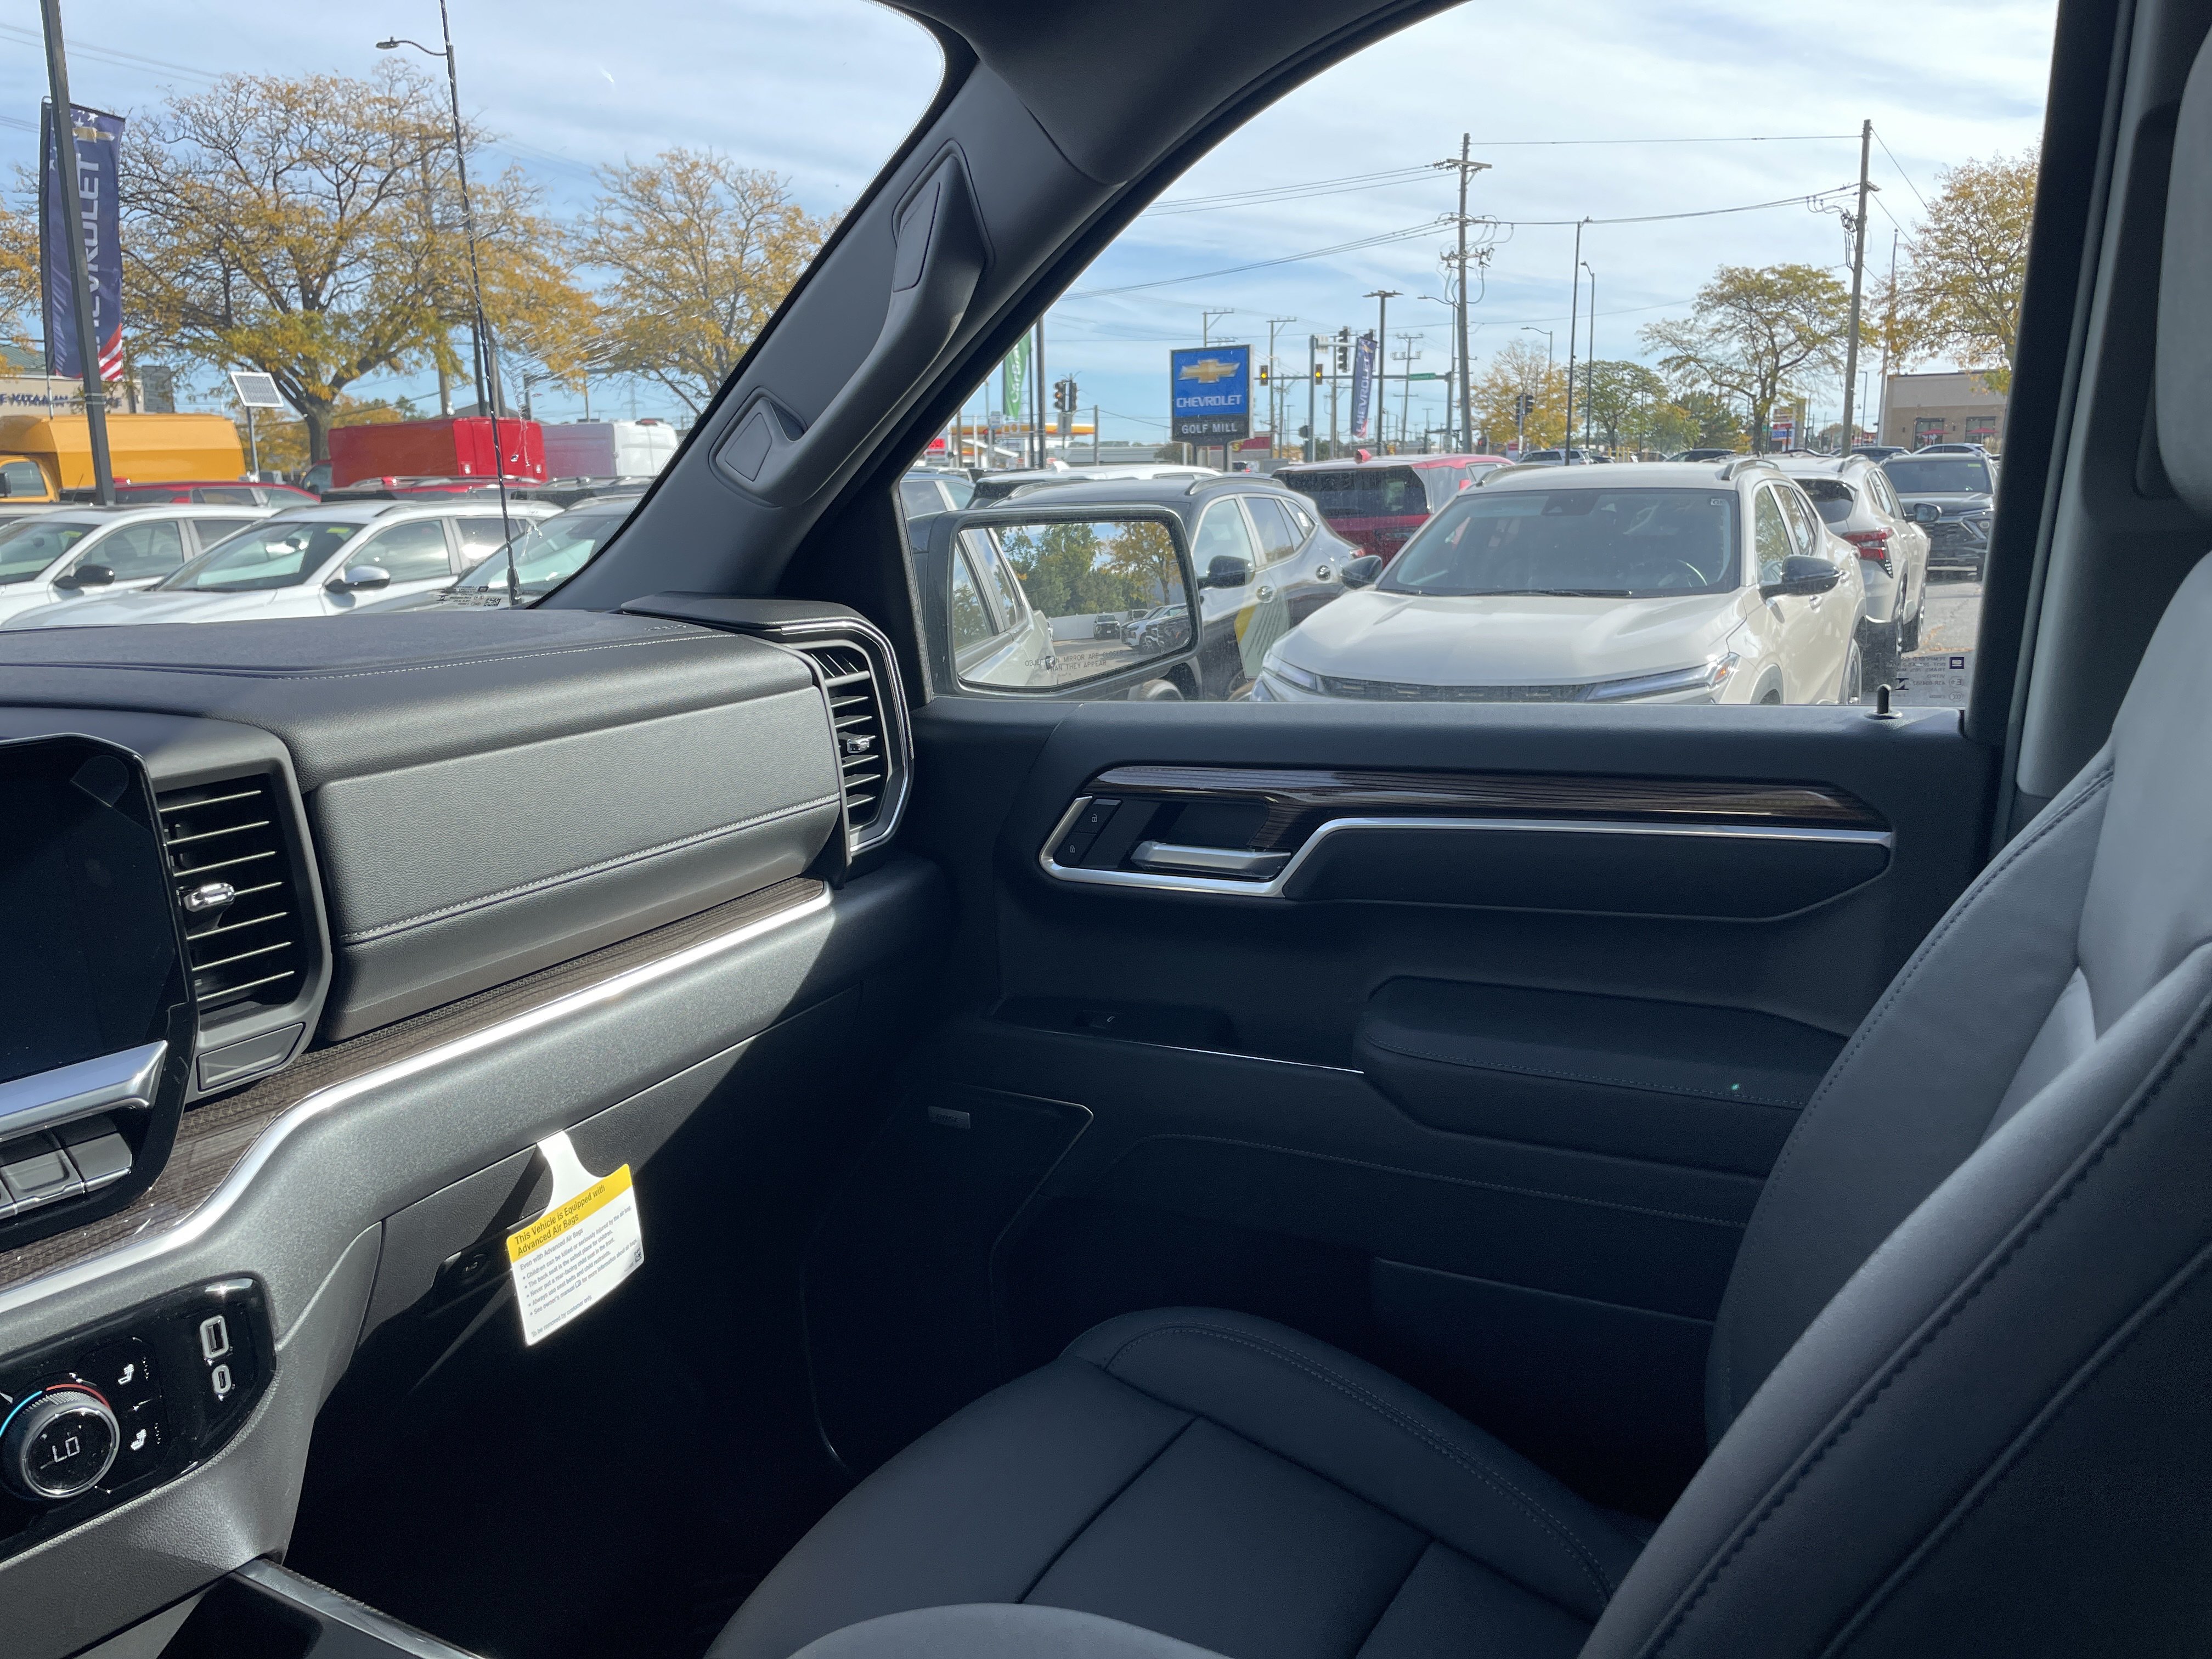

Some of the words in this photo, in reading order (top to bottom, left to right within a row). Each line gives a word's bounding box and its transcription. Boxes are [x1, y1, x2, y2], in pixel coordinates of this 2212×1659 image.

[75, 152, 101, 353] ROLET
[1176, 395, 1242, 408] CHEVROLET
[1182, 424, 1208, 434] GOLF
[1212, 422, 1238, 433] MILL
[1063, 654, 1085, 663] MIRROR
[1084, 660, 1107, 668] APPEAR
[515, 1231, 531, 1245] This
[531, 1217, 556, 1235] Vehicle
[557, 1212, 563, 1221] is
[564, 1192, 592, 1216] Equipped
[592, 1185, 606, 1198] with
[518, 1229, 551, 1256] Advanced
[553, 1223, 562, 1235] Air
[563, 1214, 579, 1228] Bags
[520, 1260, 532, 1271] Even
[533, 1253, 543, 1263] with
[544, 1238, 566, 1257] Advanced
[572, 1228, 583, 1239] Bags
[527, 1265, 546, 1279] Children
[546, 1259, 555, 1267] can
[561, 1246, 573, 1257] killed
[528, 1279, 537, 1288] The
[538, 1272, 549, 1282] back
[549, 1266, 558, 1276] seat
[530, 1285, 543, 1297] Never
[544, 1280, 552, 1289] put
[532, 1293, 548, 1306] Always
[556, 1280, 566, 1290] seat
[534, 1306, 543, 1314] See
[560, 1284, 575, 1298] manual
[543, 1315, 561, 1330] removed
